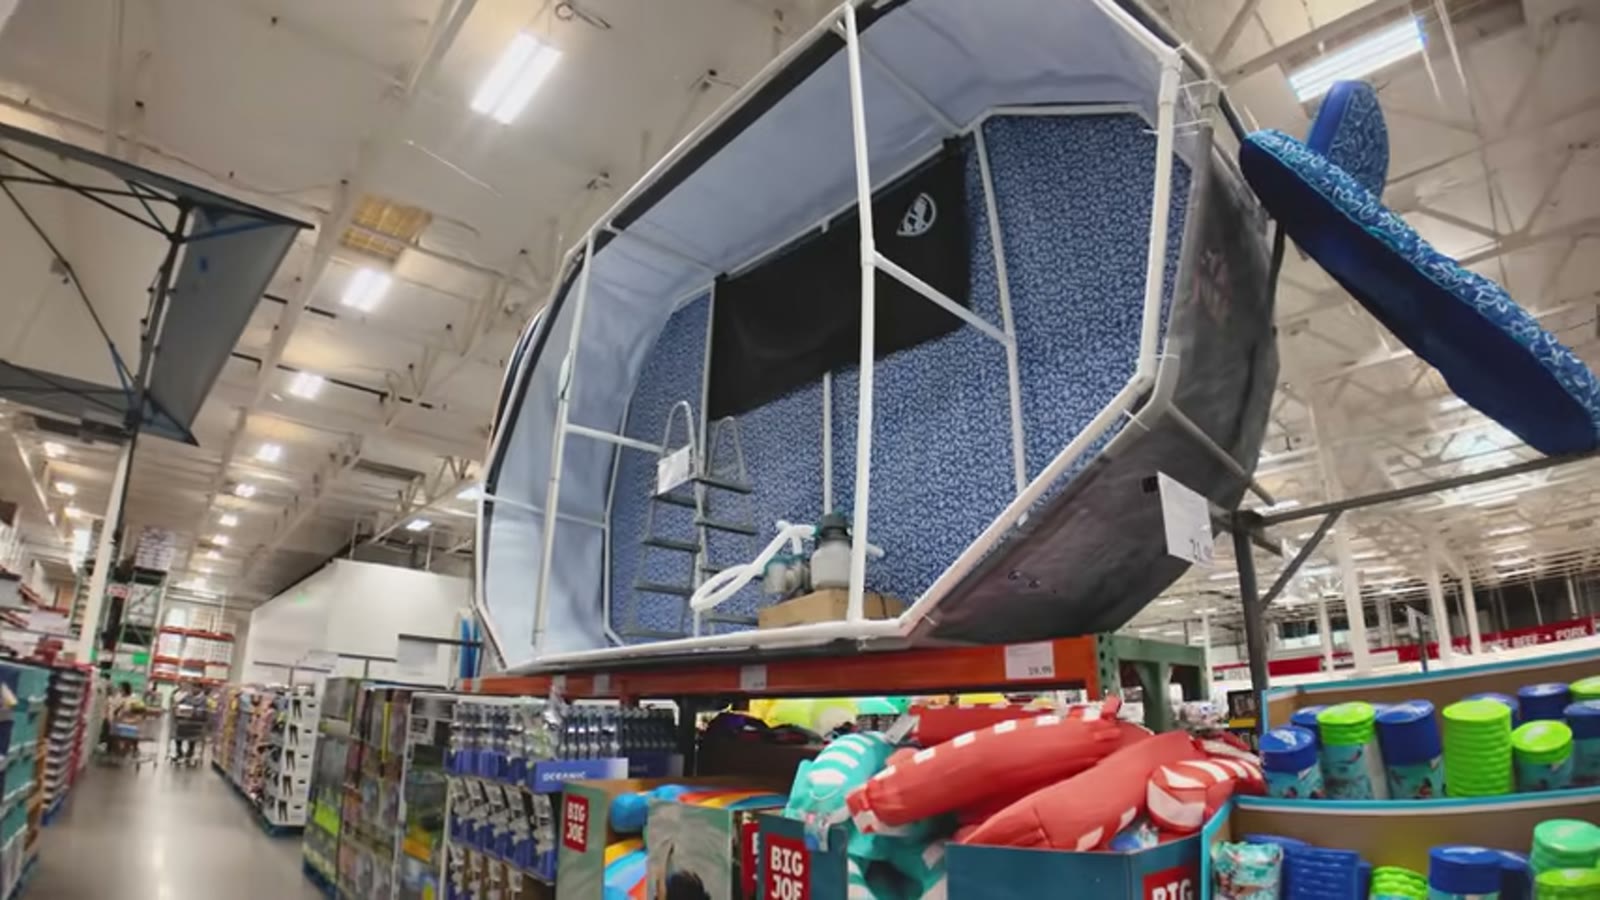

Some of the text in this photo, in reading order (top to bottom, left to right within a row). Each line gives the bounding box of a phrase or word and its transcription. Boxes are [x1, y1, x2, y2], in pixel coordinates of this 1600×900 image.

[1555, 626, 1588, 641] PORK
[567, 801, 586, 823] BIG
[566, 821, 586, 844] JOE
[771, 845, 804, 877] BIG
[771, 873, 803, 900] JOE
